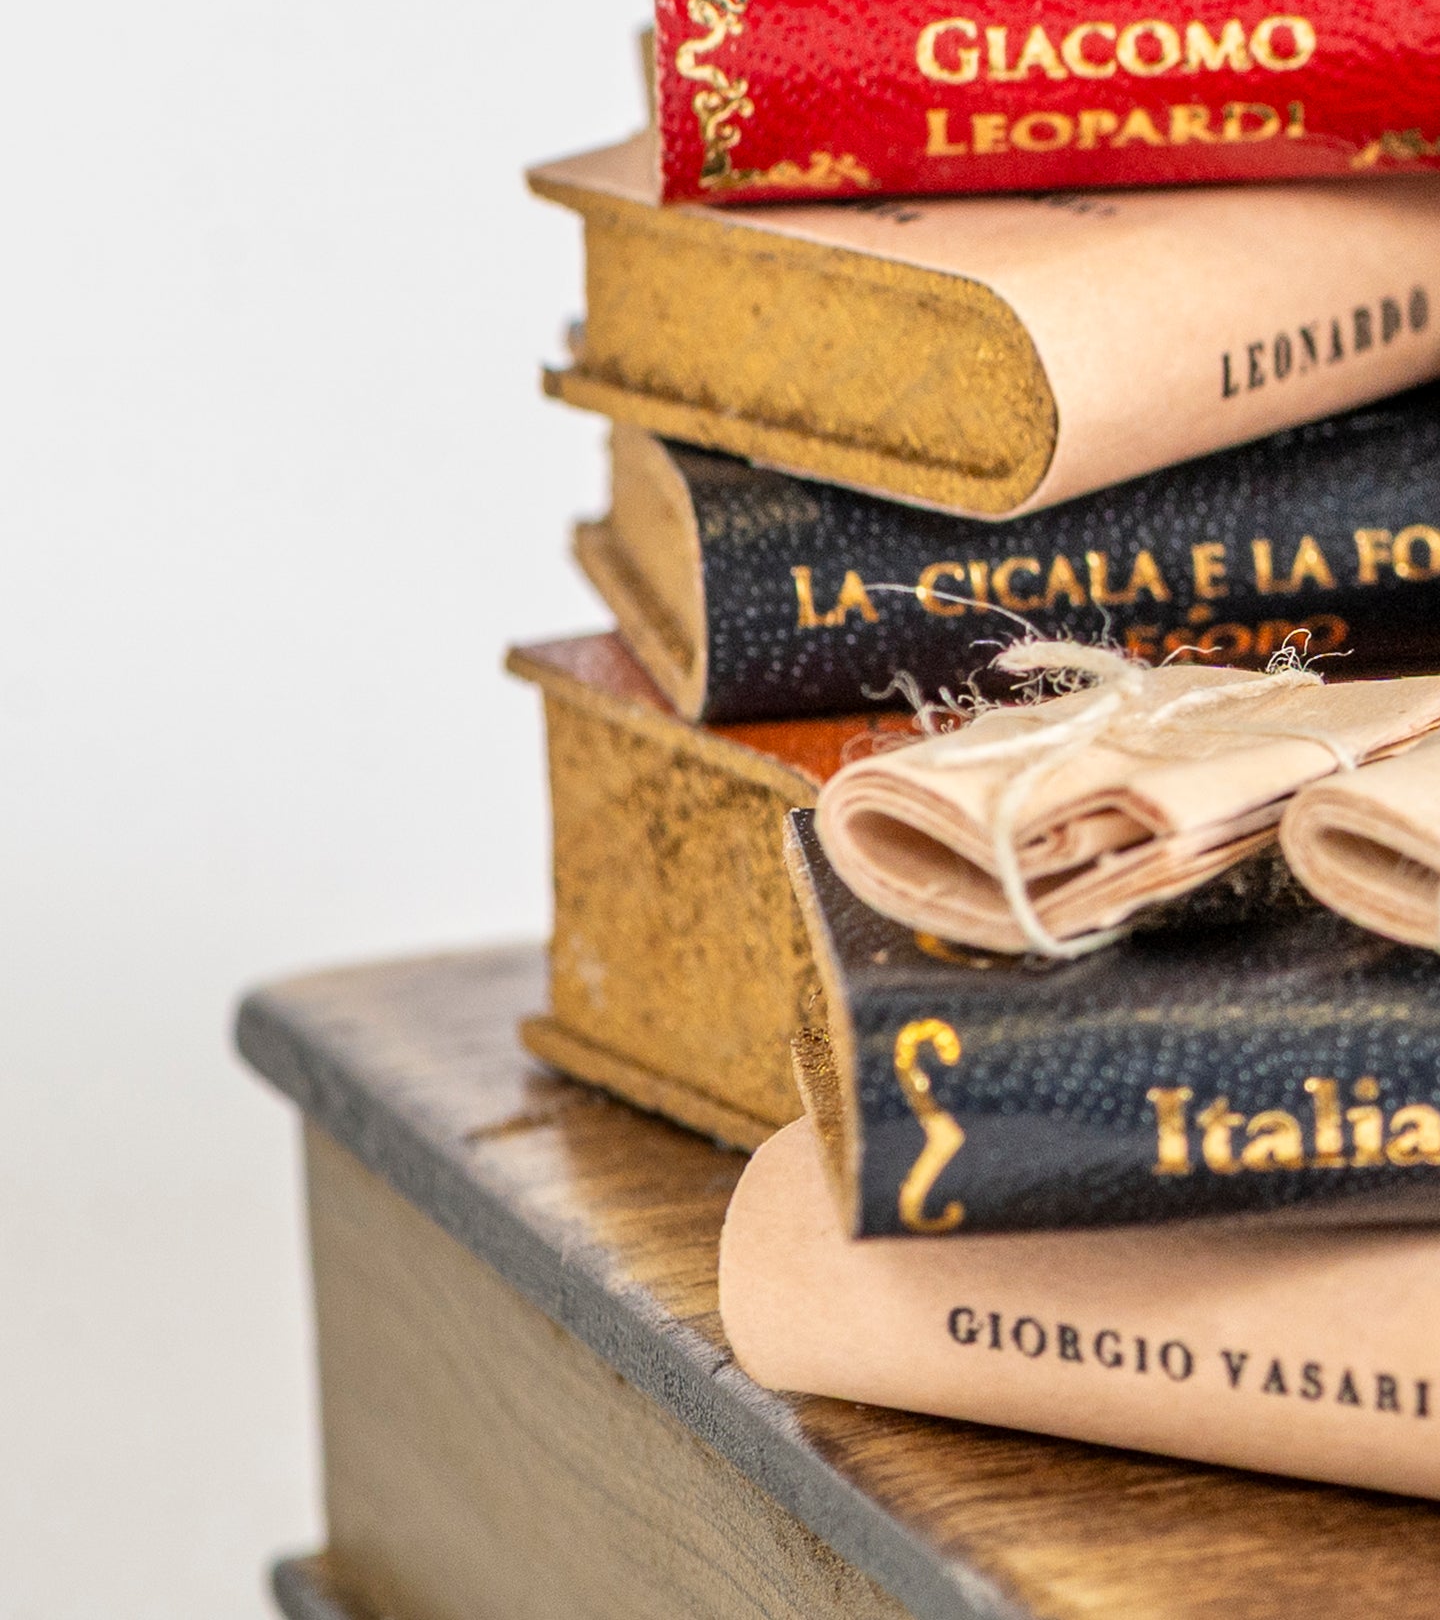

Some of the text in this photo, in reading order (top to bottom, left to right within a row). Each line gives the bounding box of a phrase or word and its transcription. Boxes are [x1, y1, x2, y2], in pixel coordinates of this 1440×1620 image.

[916, 15, 1316, 86] GIACOMO
[927, 100, 1305, 157] LEOPARDI
[1221, 284, 1430, 400] LEONARDO
[793, 565, 877, 630] LA
[920, 542, 1171, 621] CICALA
[1191, 542, 1231, 599] E
[1252, 535, 1336, 594] LA
[948, 1306, 1434, 1420] GIORGIO VASARI
